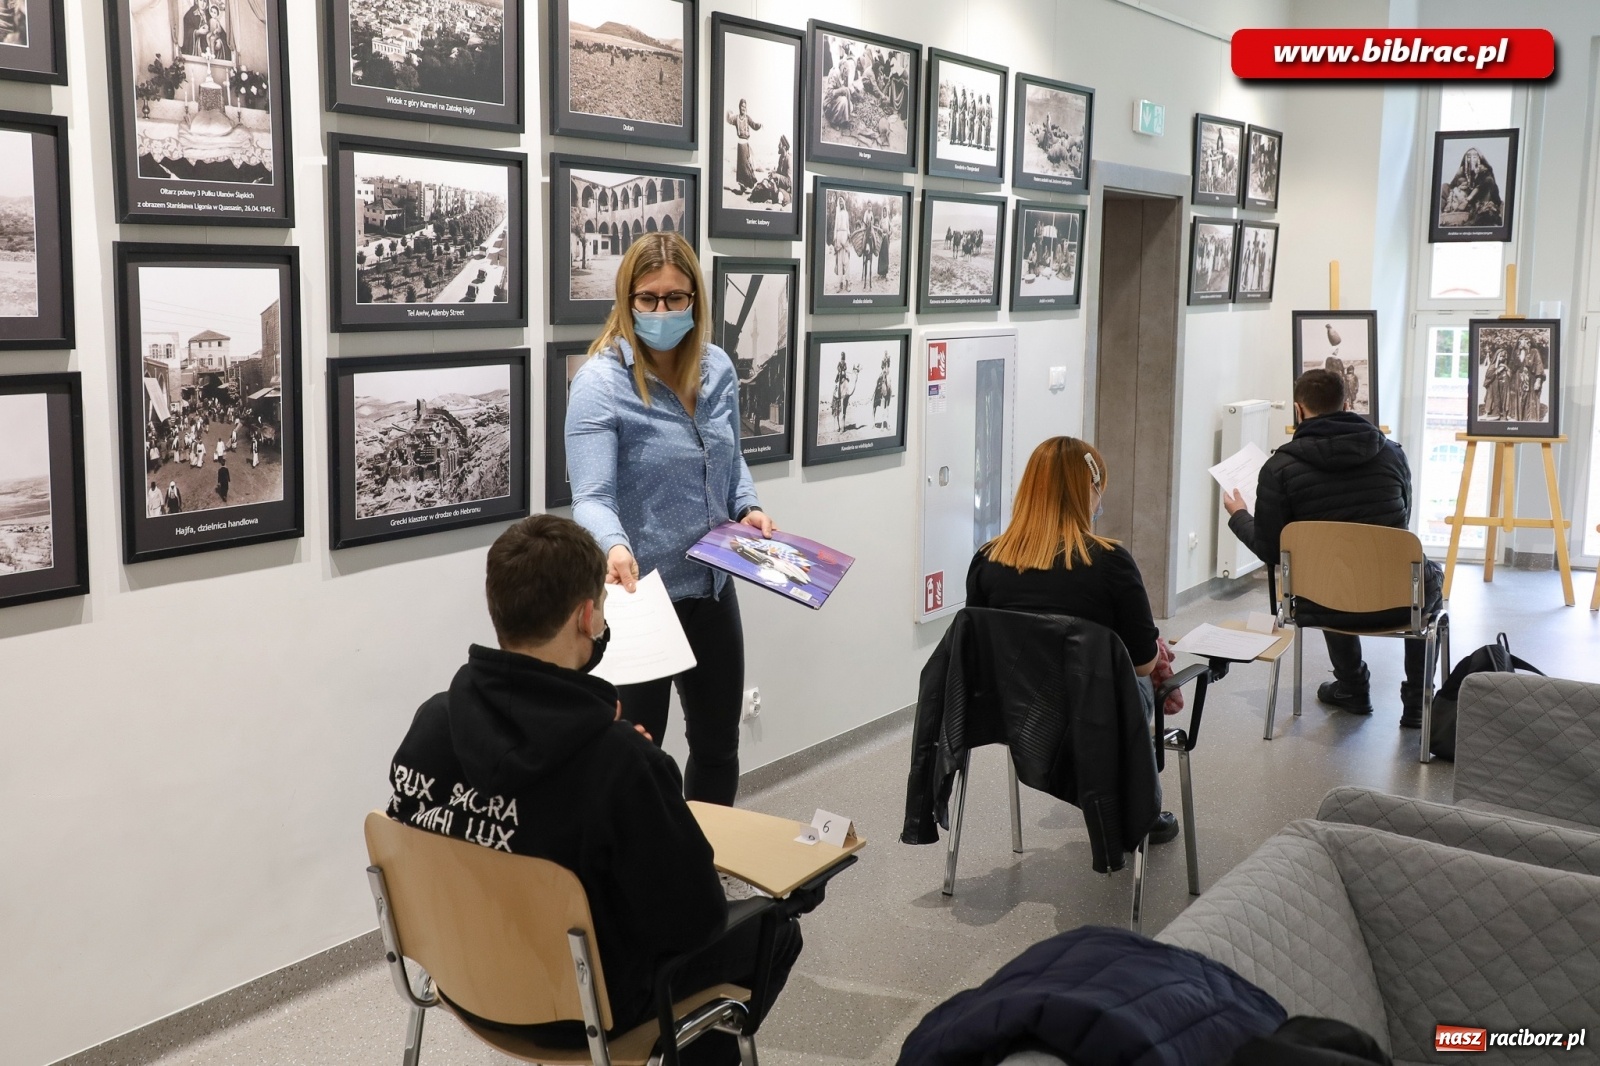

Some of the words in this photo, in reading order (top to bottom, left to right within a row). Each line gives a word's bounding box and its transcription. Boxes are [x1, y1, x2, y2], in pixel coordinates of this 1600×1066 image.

[386, 95, 403, 106] Widok
[408, 99, 419, 108] góry
[420, 100, 438, 110] Karmel
[177, 189, 196, 198] polowy
[142, 201, 166, 209] obrazem
[407, 309, 415, 317] Tel
[430, 309, 449, 318] Allenby
[449, 308, 465, 316] Street
[390, 517, 408, 527] Grecki
[408, 514, 428, 524] klasztor
[434, 510, 453, 519] drodze
[452, 509, 460, 517] do
[460, 506, 482, 515] Hebronu
[175, 525, 196, 536] Hajfa,
[197, 520, 228, 532] dzielnica
[227, 517, 259, 528] handlowa
[448, 782, 519, 827] SACRA
[464, 816, 515, 853] LUX
[822, 820, 832, 834] 6
